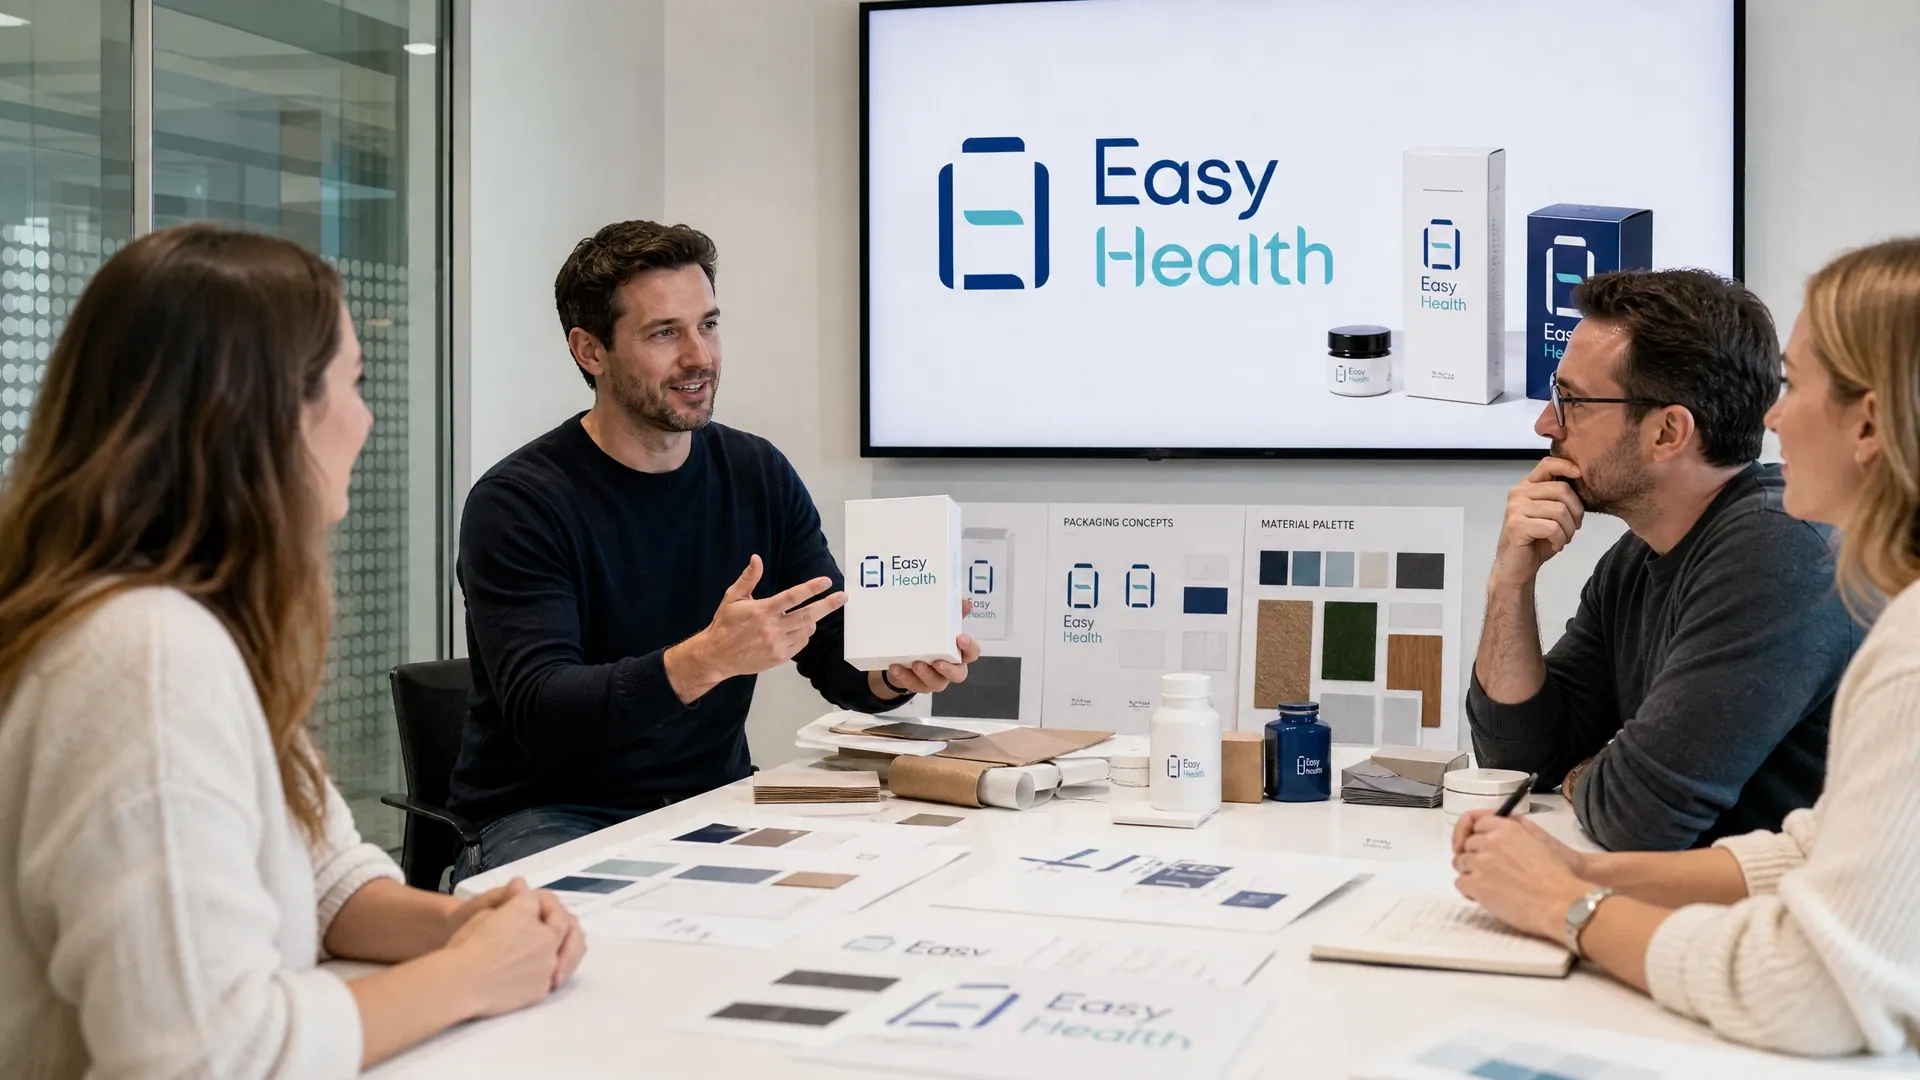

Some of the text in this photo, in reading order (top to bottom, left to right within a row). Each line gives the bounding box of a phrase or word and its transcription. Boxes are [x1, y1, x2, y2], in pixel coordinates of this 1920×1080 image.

[1096, 138, 1279, 220] Easy
[1096, 226, 1334, 287] Health
[1421, 275, 1457, 296] Easy
[1421, 295, 1467, 311] Health
[1544, 322, 1573, 342] Eas
[1063, 517, 1174, 528] PACKAGING CONCEPTS
[1261, 519, 1355, 530] MATERIAL PALETTE
[892, 555, 928, 572] Easy
[892, 572, 937, 586] Health
[1063, 614, 1095, 631] Easy
[1063, 631, 1103, 644] Health
[1045, 991, 1175, 1026] Easy
[1020, 1015, 1193, 1050] Health
